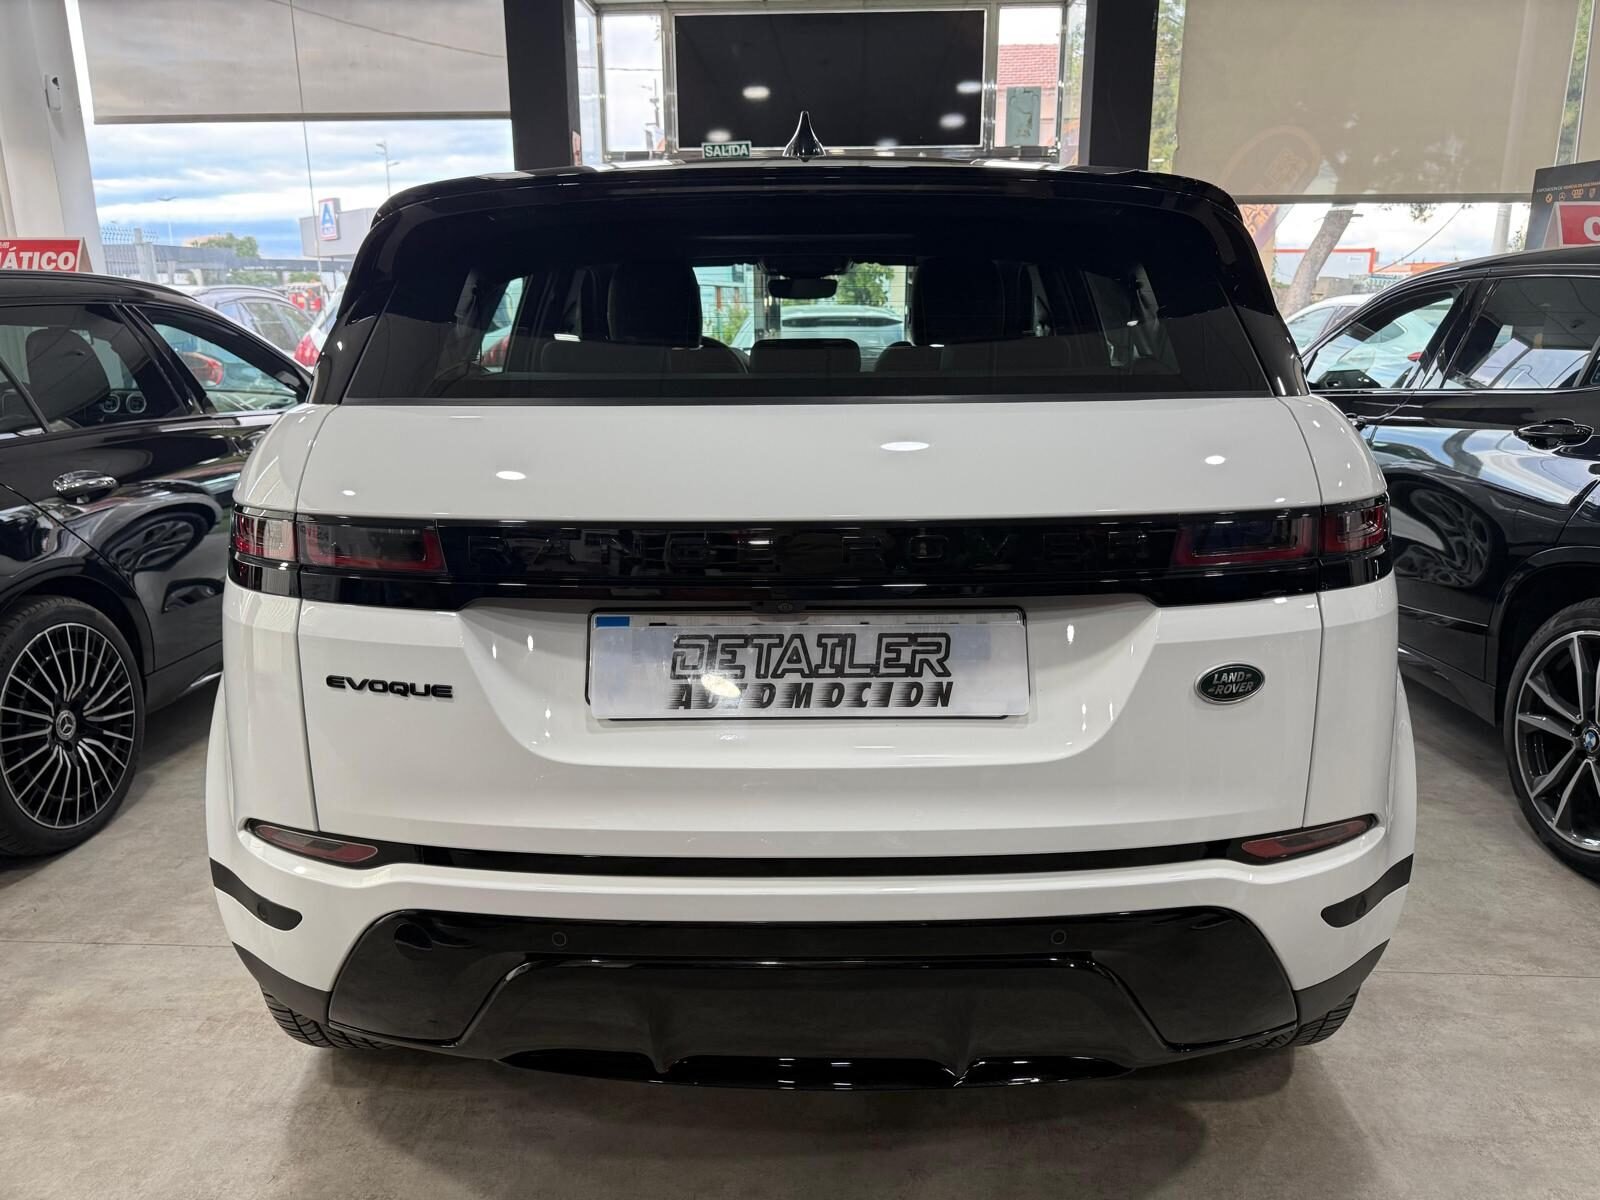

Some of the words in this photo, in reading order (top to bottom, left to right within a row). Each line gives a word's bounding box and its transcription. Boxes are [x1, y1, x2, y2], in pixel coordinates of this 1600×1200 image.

[705, 144, 749, 157] SALIDA
[0, 246, 76, 270] ÁTICO
[670, 633, 952, 679] DETAILER
[326, 675, 454, 698] EVOQUE
[1212, 671, 1246, 685] LAND
[1214, 681, 1255, 695] ROVER
